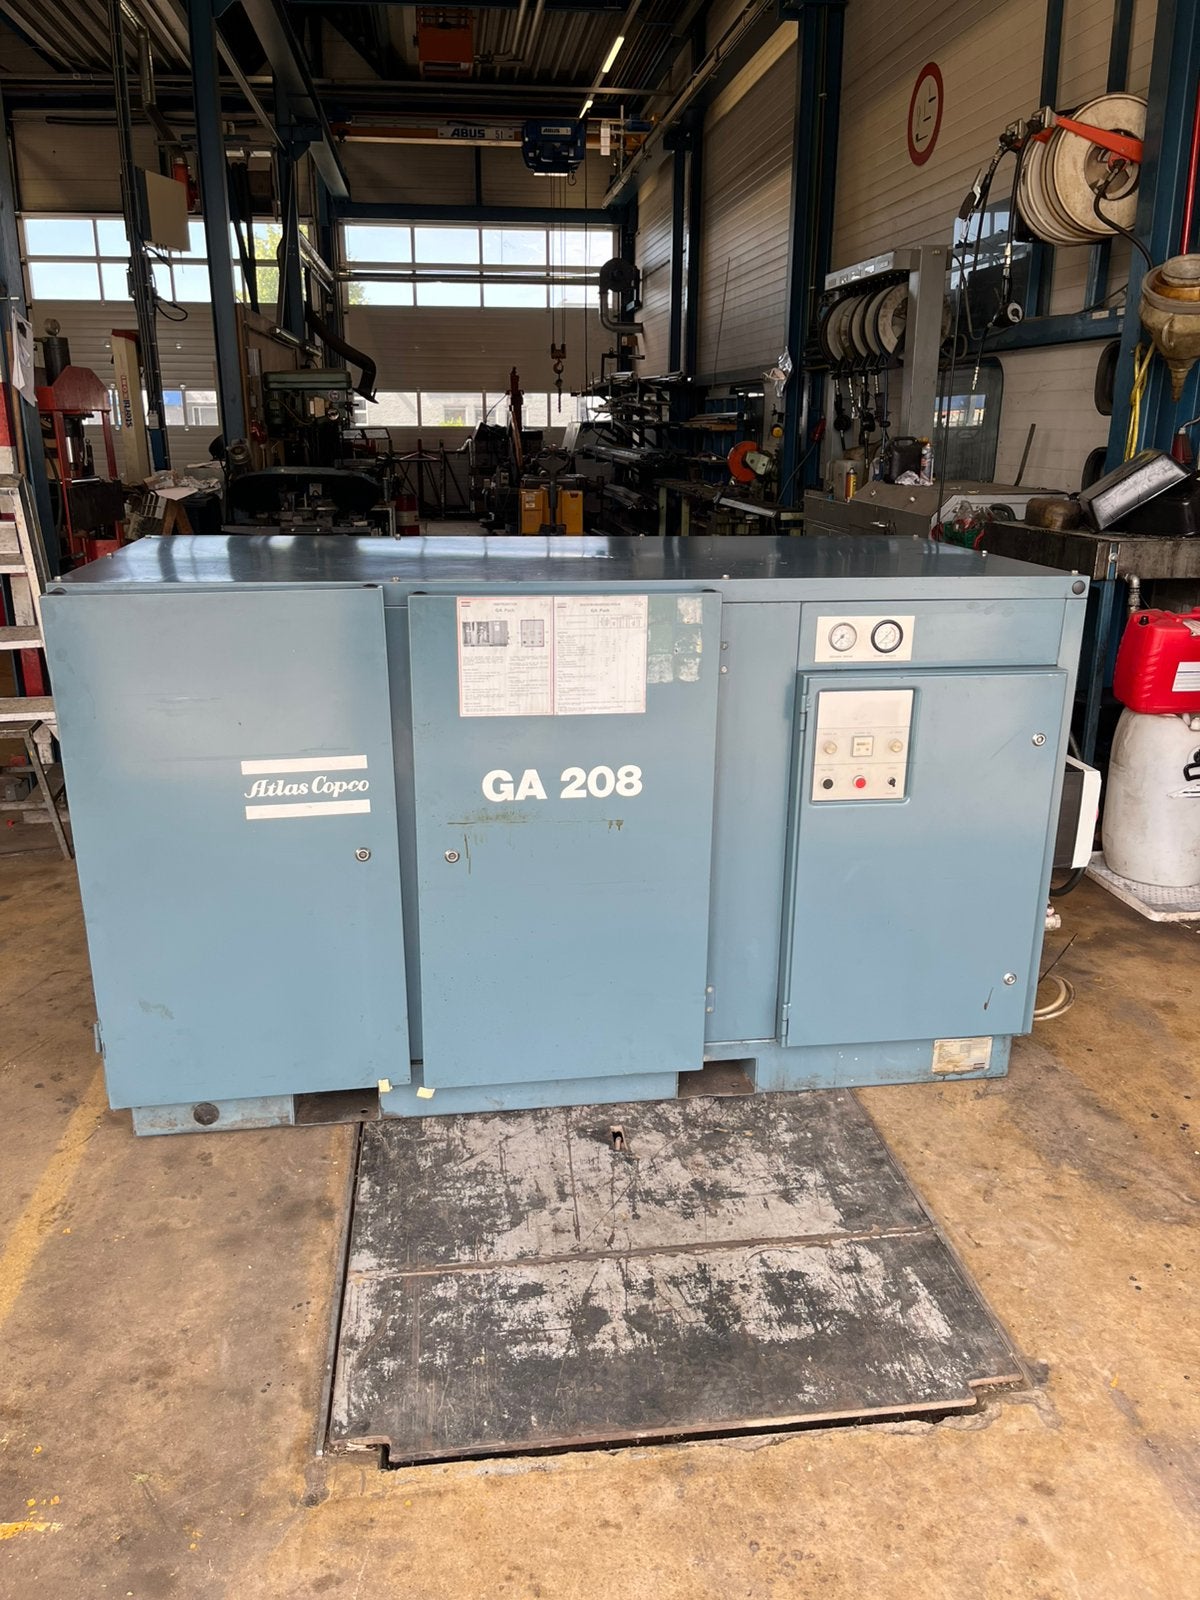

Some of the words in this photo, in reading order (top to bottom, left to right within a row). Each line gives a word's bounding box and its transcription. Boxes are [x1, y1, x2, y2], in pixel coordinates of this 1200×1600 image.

[451, 128, 485, 138] ABUS
[244, 779, 309, 799] Atlas
[311, 775, 369, 798] Copco
[482, 769, 548, 803] GA
[560, 764, 643, 799] 208
